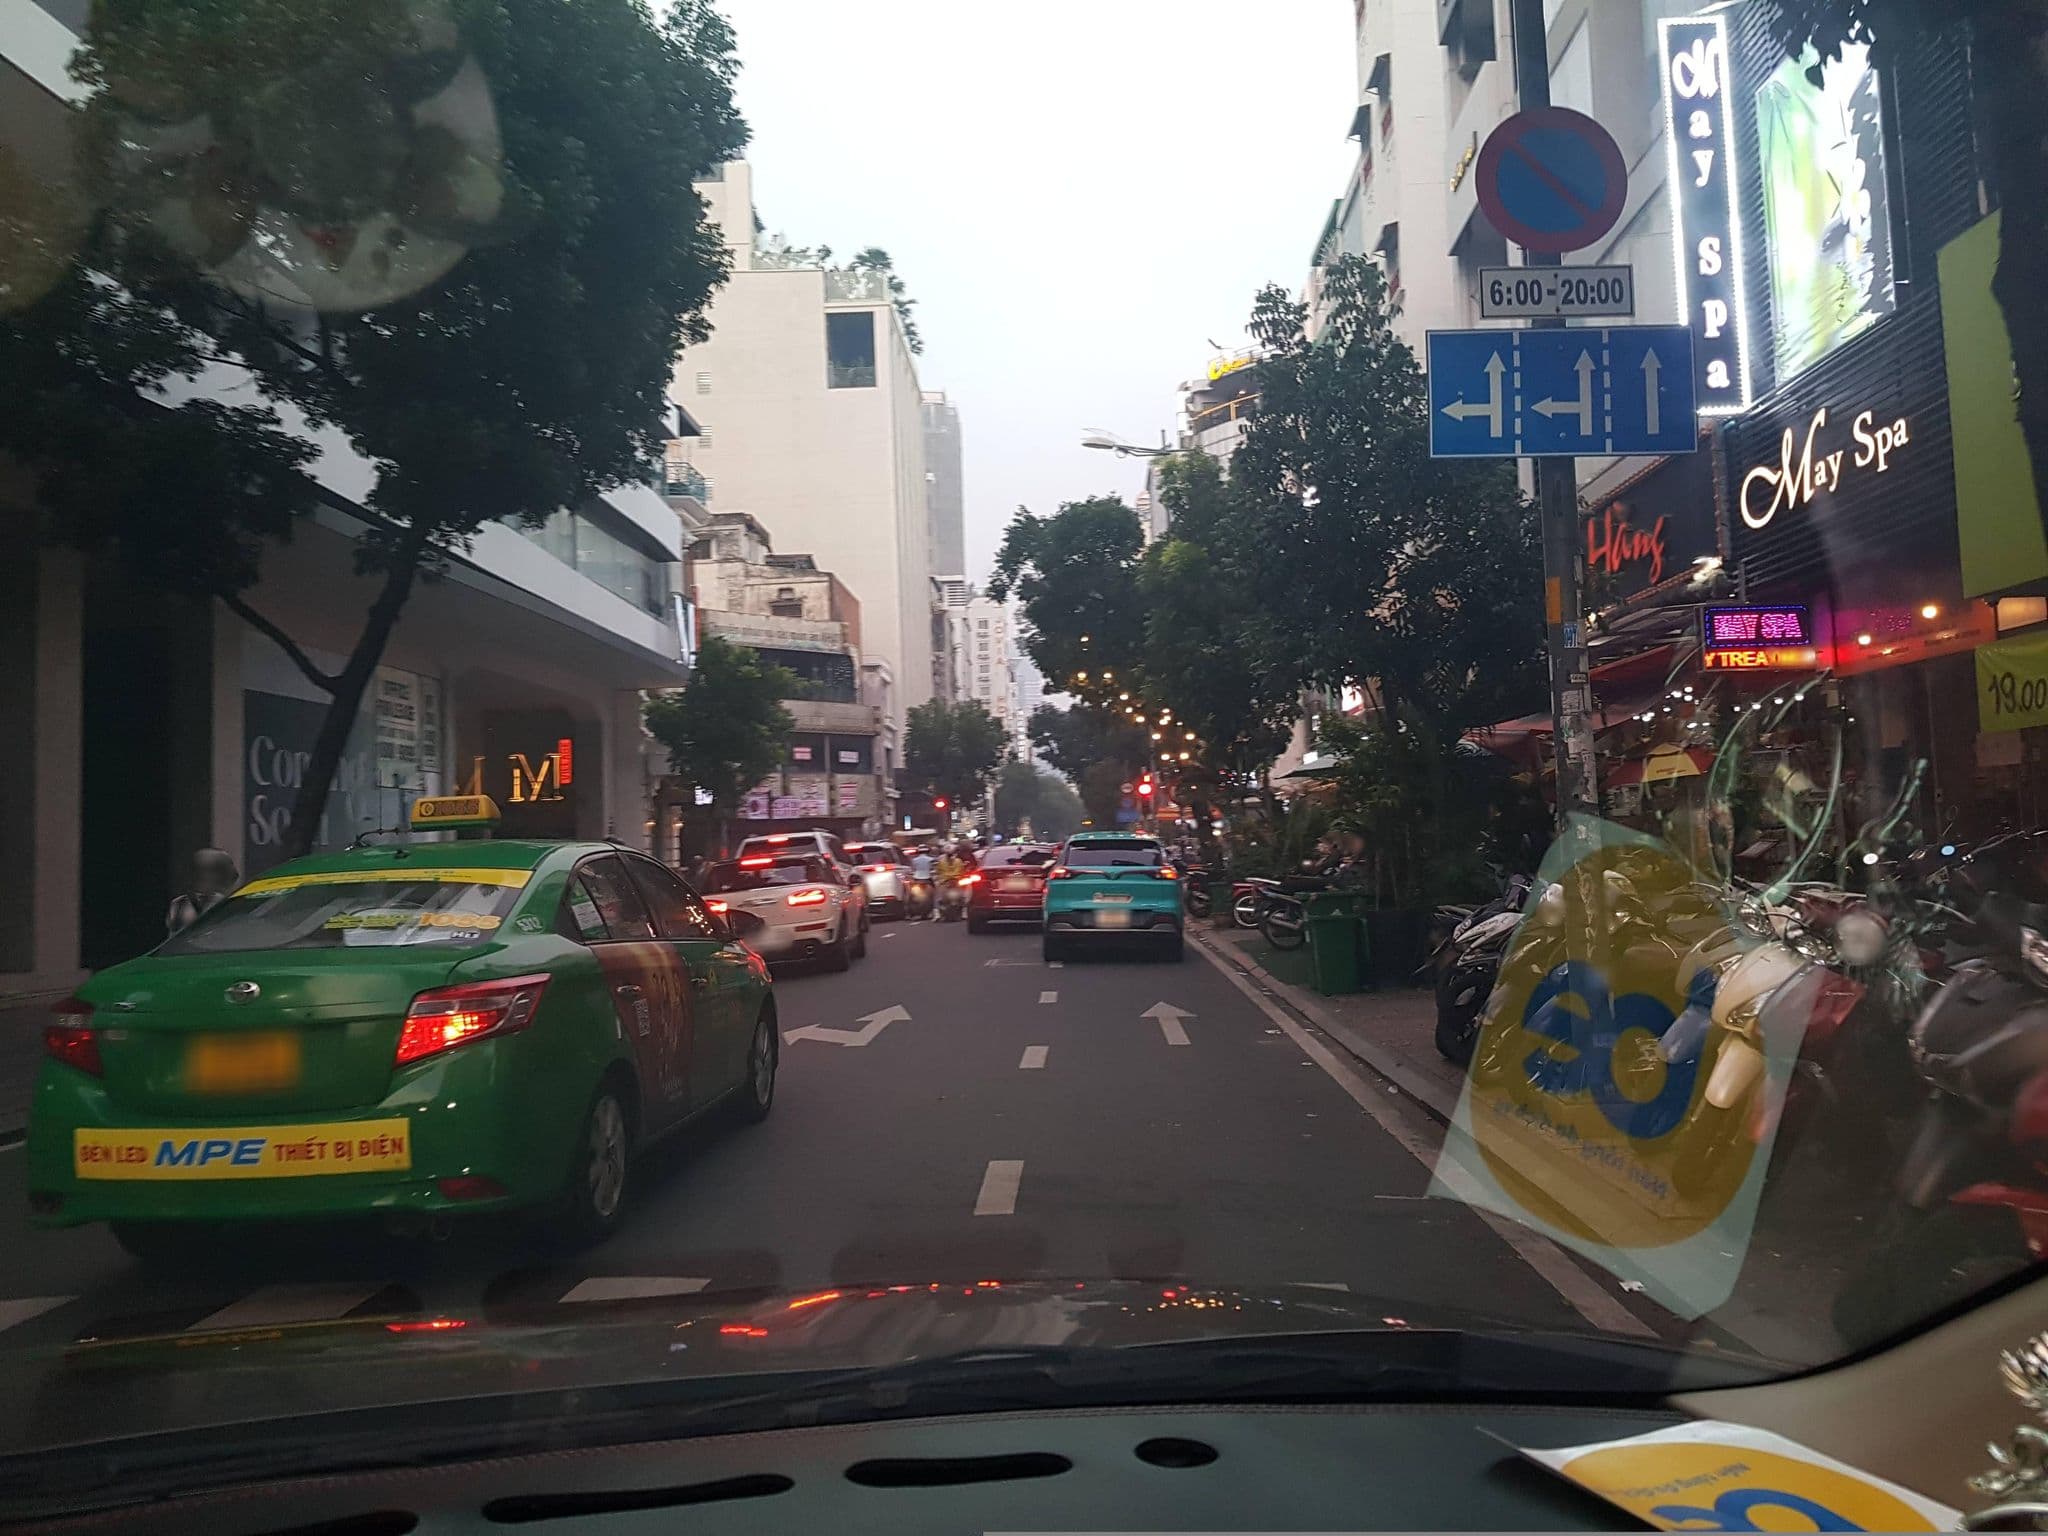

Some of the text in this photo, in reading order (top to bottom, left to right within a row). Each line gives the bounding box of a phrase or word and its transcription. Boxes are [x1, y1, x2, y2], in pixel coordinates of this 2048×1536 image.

[1671, 37, 1721, 189] May
[1740, 407, 1910, 530] May Spa
[155, 1137, 268, 1167] MPE
